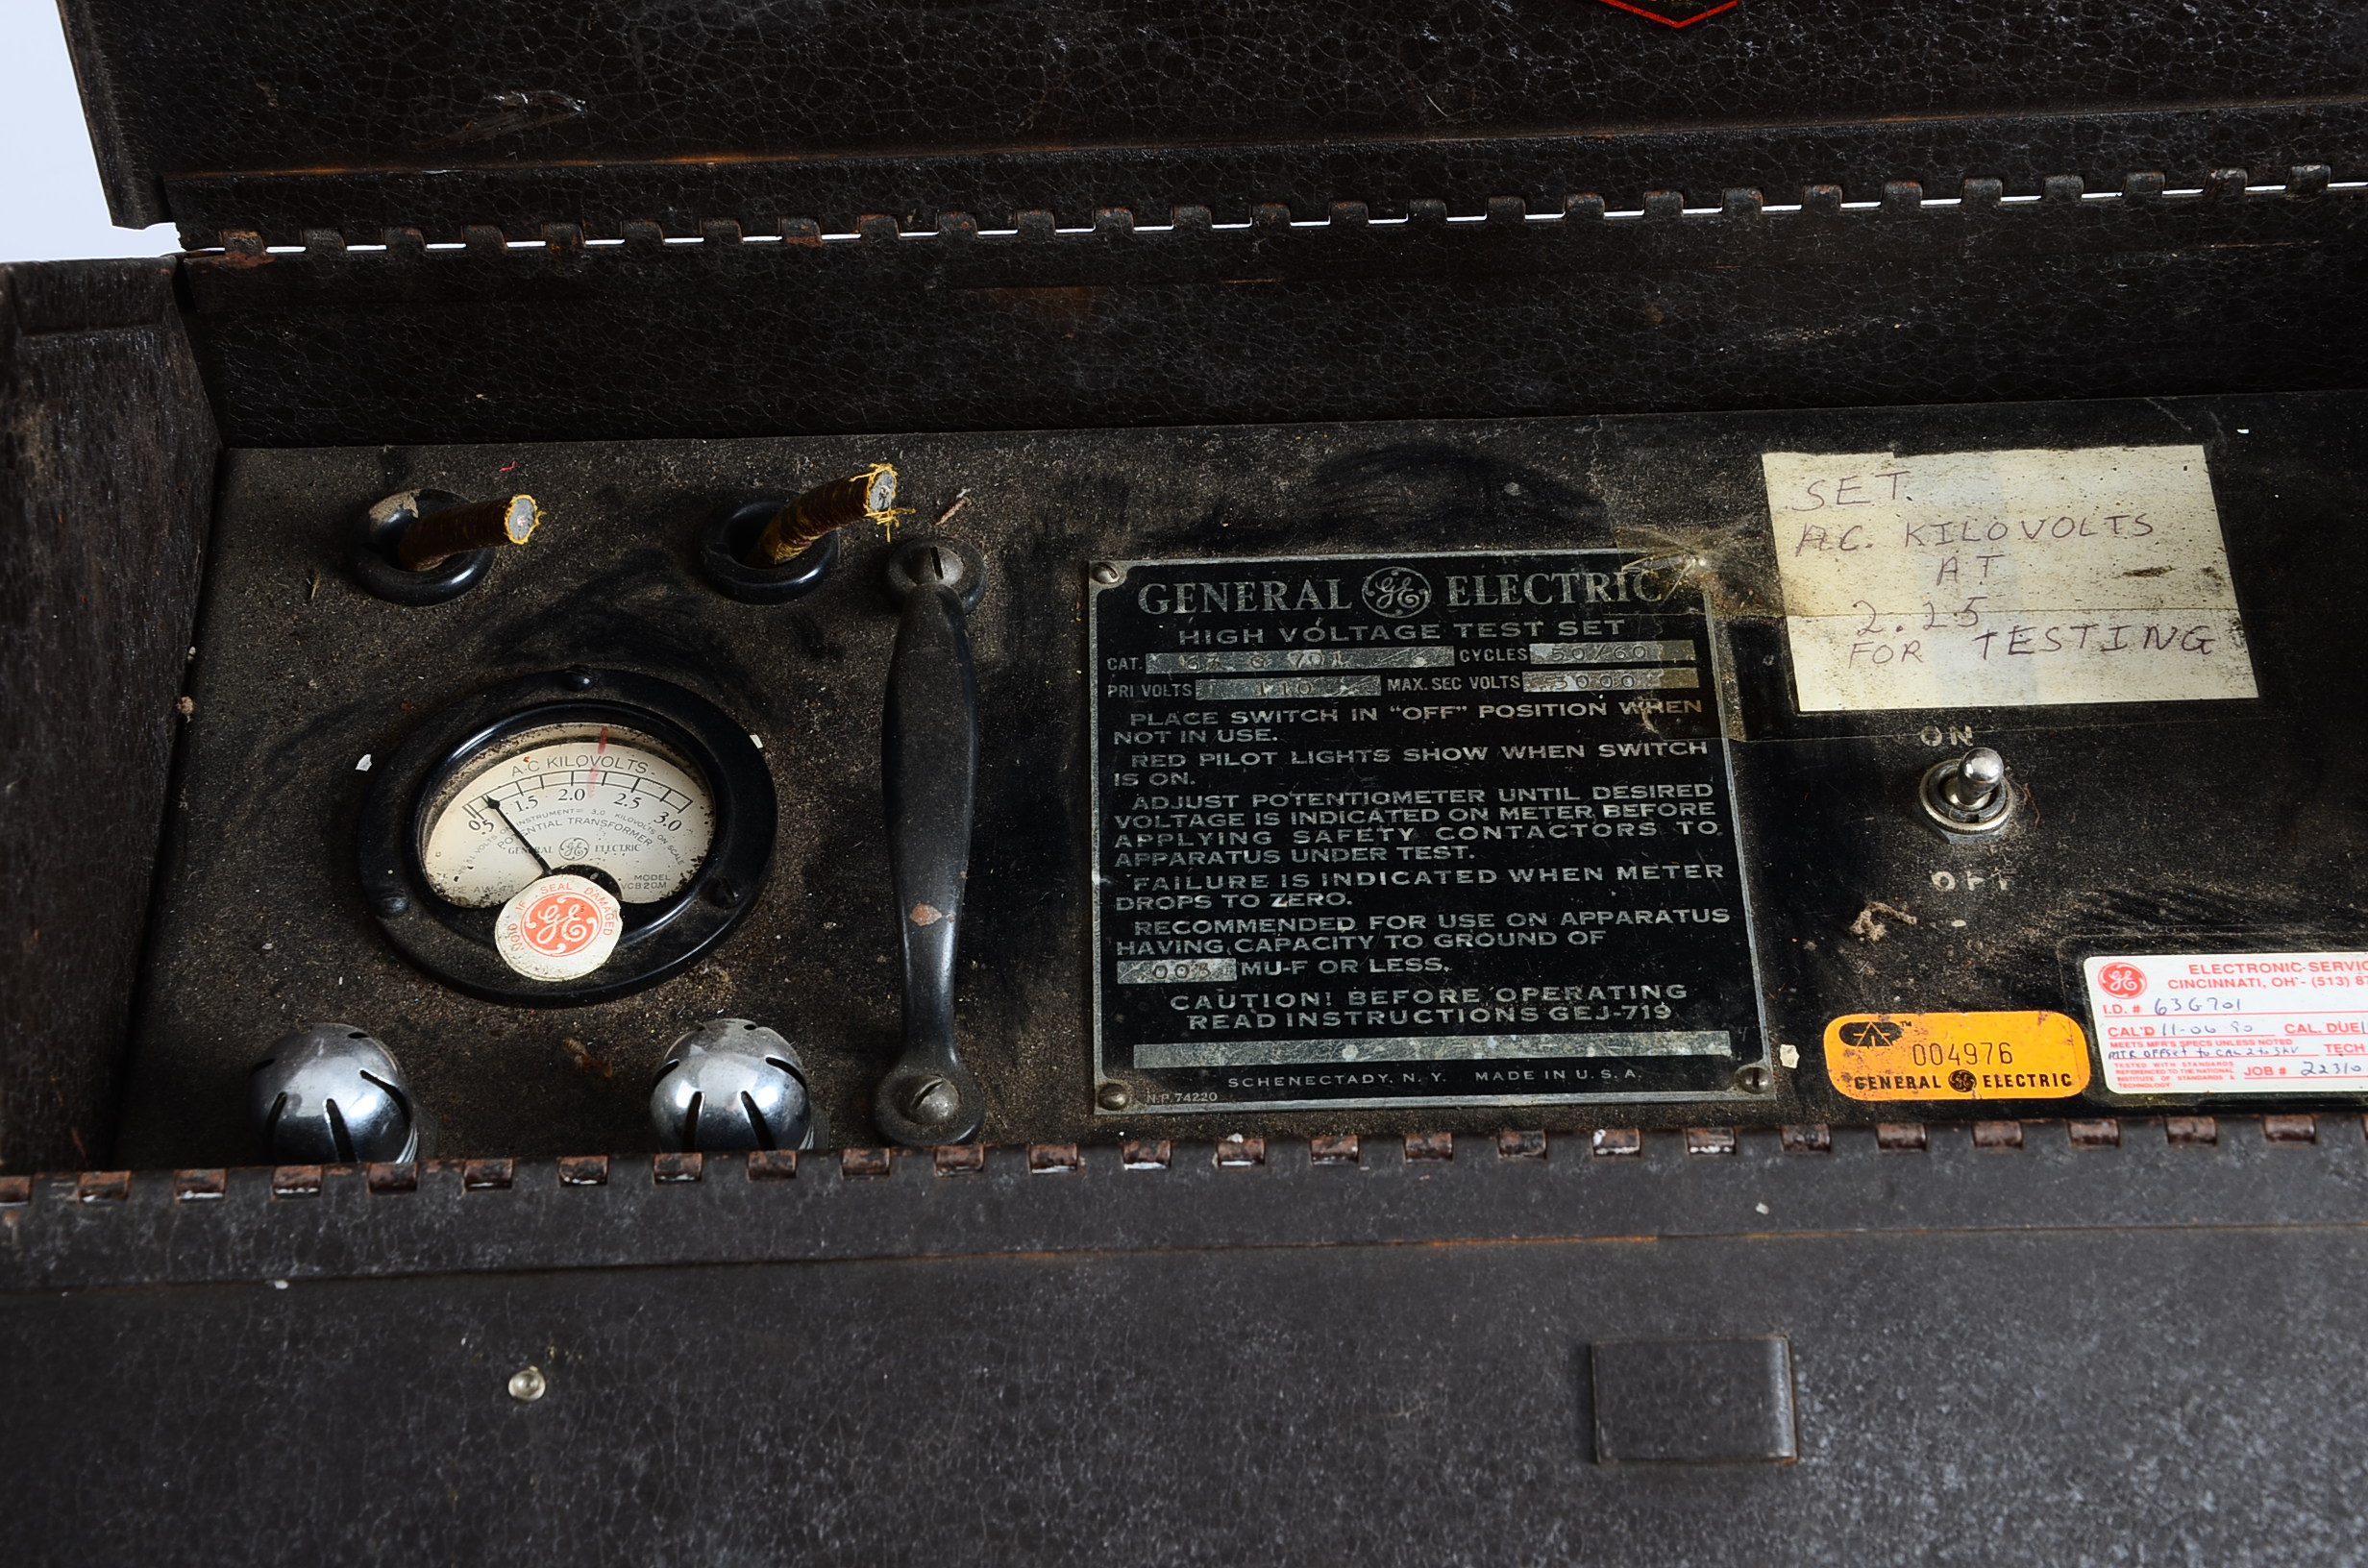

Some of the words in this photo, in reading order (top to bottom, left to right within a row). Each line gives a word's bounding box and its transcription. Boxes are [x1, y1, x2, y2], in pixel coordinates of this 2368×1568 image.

[1791, 470, 1910, 512] SET
[1904, 513, 2156, 549] KILOVOLTS
[1936, 553, 2005, 586] AT
[1138, 578, 1352, 615] GENERAL
[1445, 571, 1663, 606] ELECTRIC
[1853, 596, 1987, 635] 2.25
[1178, 629, 1264, 645] HIGH
[1279, 624, 1441, 643] VOLTAGE
[1453, 621, 1544, 638] TEST
[1558, 619, 1625, 637] SET
[1106, 657, 1143, 672] CAT.
[1459, 648, 1528, 663] CYCLES
[1551, 645, 1647, 662] 50/60
[1849, 639, 1923, 670] FOR
[1973, 625, 2217, 662] TESTING
[1107, 683, 1134, 698] PRI
[1142, 682, 1192, 698] VOLTS
[1387, 677, 1428, 693] MAX.
[1431, 675, 1462, 691] SEC
[1469, 674, 1520, 690] VOLTS
[1130, 711, 1219, 726] PLACE
[1231, 709, 1339, 724] SWITCH
[1351, 707, 1378, 722] IN
[1478, 702, 1608, 719] POSITION
[1618, 699, 1703, 715] WHEN
[1113, 730, 1171, 745] NOT
[1180, 729, 1206, 744] IN
[1217, 728, 1278, 744] USE.
[1920, 725, 1973, 747] ON
[547, 754, 649, 774] KILOVOLTS
[1131, 753, 1187, 769] RED
[1199, 751, 1278, 767] PILOT
[1291, 748, 1392, 765] LIGHTS
[1403, 746, 1489, 762] SHOW
[1500, 745, 1585, 760] WHEN
[1598, 741, 1708, 758] SWITCH
[1113, 772, 1139, 787] IS
[1148, 772, 1196, 786] ON.
[1131, 795, 1240, 811] ADJUST
[1252, 789, 1486, 808] POTENTIOMETER
[1497, 787, 1581, 802] UNTIL
[1592, 783, 1714, 800] DESIRED
[514, 795, 538, 813] 1.5
[557, 788, 585, 801] 2.0
[613, 793, 642, 809] 2.5
[653, 811, 682, 832] 3.0
[1114, 813, 1246, 829] VOLTAGE
[1254, 812, 1281, 826] IS
[1291, 808, 1440, 825] INDICATED
[1448, 807, 1489, 822] ON
[1499, 805, 1593, 821] METER
[1602, 801, 1716, 818] BEFORE
[567, 817, 654, 846] TRANSFORMER
[614, 813, 656, 835] KILOVOLTS
[656, 833, 669, 845] ON
[667, 844, 685, 866] SCALE
[1114, 830, 1272, 848] APPLYING
[1293, 827, 1415, 845] SAFETY
[1435, 821, 1656, 841] CONTACTORS
[1675, 821, 1718, 836] TO
[594, 844, 641, 852] ELECTRIC
[1115, 849, 1281, 868] APPARATUS
[1291, 846, 1387, 863] UNDER
[1396, 845, 1474, 861] TEST.
[540, 882, 573, 894] SEAL
[1133, 873, 1270, 892] FAILURE
[1280, 872, 1311, 888] IS
[1321, 870, 1497, 888] INDICATED
[1507, 867, 1604, 883] WHEN
[1616, 864, 1724, 881] METER
[514, 900, 528, 912] IF
[583, 887, 616, 936] DAMAGED
[1115, 894, 1213, 911] DROPS
[1221, 893, 1260, 909] TO
[1270, 892, 1353, 908] ZERO.
[1133, 917, 1357, 936] RECOMMENDED
[1369, 915, 1426, 930] FOR
[1438, 913, 1494, 929] USE
[1506, 912, 1547, 928] ON
[1560, 908, 1731, 926] APPARATUS
[507, 922, 523, 952] VOID
[1116, 940, 1224, 956] HAVING
[1234, 935, 1374, 953] CAPACITY
[1384, 933, 1423, 949] TO
[1434, 931, 1557, 948] GROUND
[1566, 930, 1607, 946] OF
[1241, 960, 1308, 976] MU-F
[1318, 959, 1359, 974] OR
[1369, 957, 1450, 973] LESS.
[2188, 962, 2303, 975] ELECTRONIC
[2167, 977, 2267, 990] CINCINNATI,
[2271, 976, 2296, 988] OH
[2311, 976, 2350, 989] (513)
[1170, 992, 1332, 1011] CAUTION!
[1348, 988, 1480, 1006] BEFORE
[1494, 984, 1688, 1002] OPERATING
[2103, 1004, 2128, 1015] I.D.
[2133, 1004, 2140, 1014] #
[1189, 1013, 1276, 1030] READ
[1286, 1008, 1540, 1029] INSTRUCTIONS
[1548, 1005, 1672, 1021] GEJ-719
[2283, 1023, 2322, 1035] CAL.
[2326, 1022, 2360, 1033] DUE
[2108, 1026, 2155, 1038] CAL'D
[2215, 1039, 2256, 1047] UNLESS
[1912, 1041, 2014, 1066] 004976
[2324, 1043, 2364, 1053] TECH
[1475, 1070, 1535, 1082] MADE
[1544, 1069, 1566, 1081] IN
[1854, 1074, 1942, 1090] GENERAL
[1984, 1072, 2072, 1089] ELECTRIC
[2244, 1066, 2274, 1077] JOB
[2279, 1066, 2287, 1075] #
[2301, 1061, 2362, 1076] 22310
[1174, 1091, 1219, 1104] 74220
